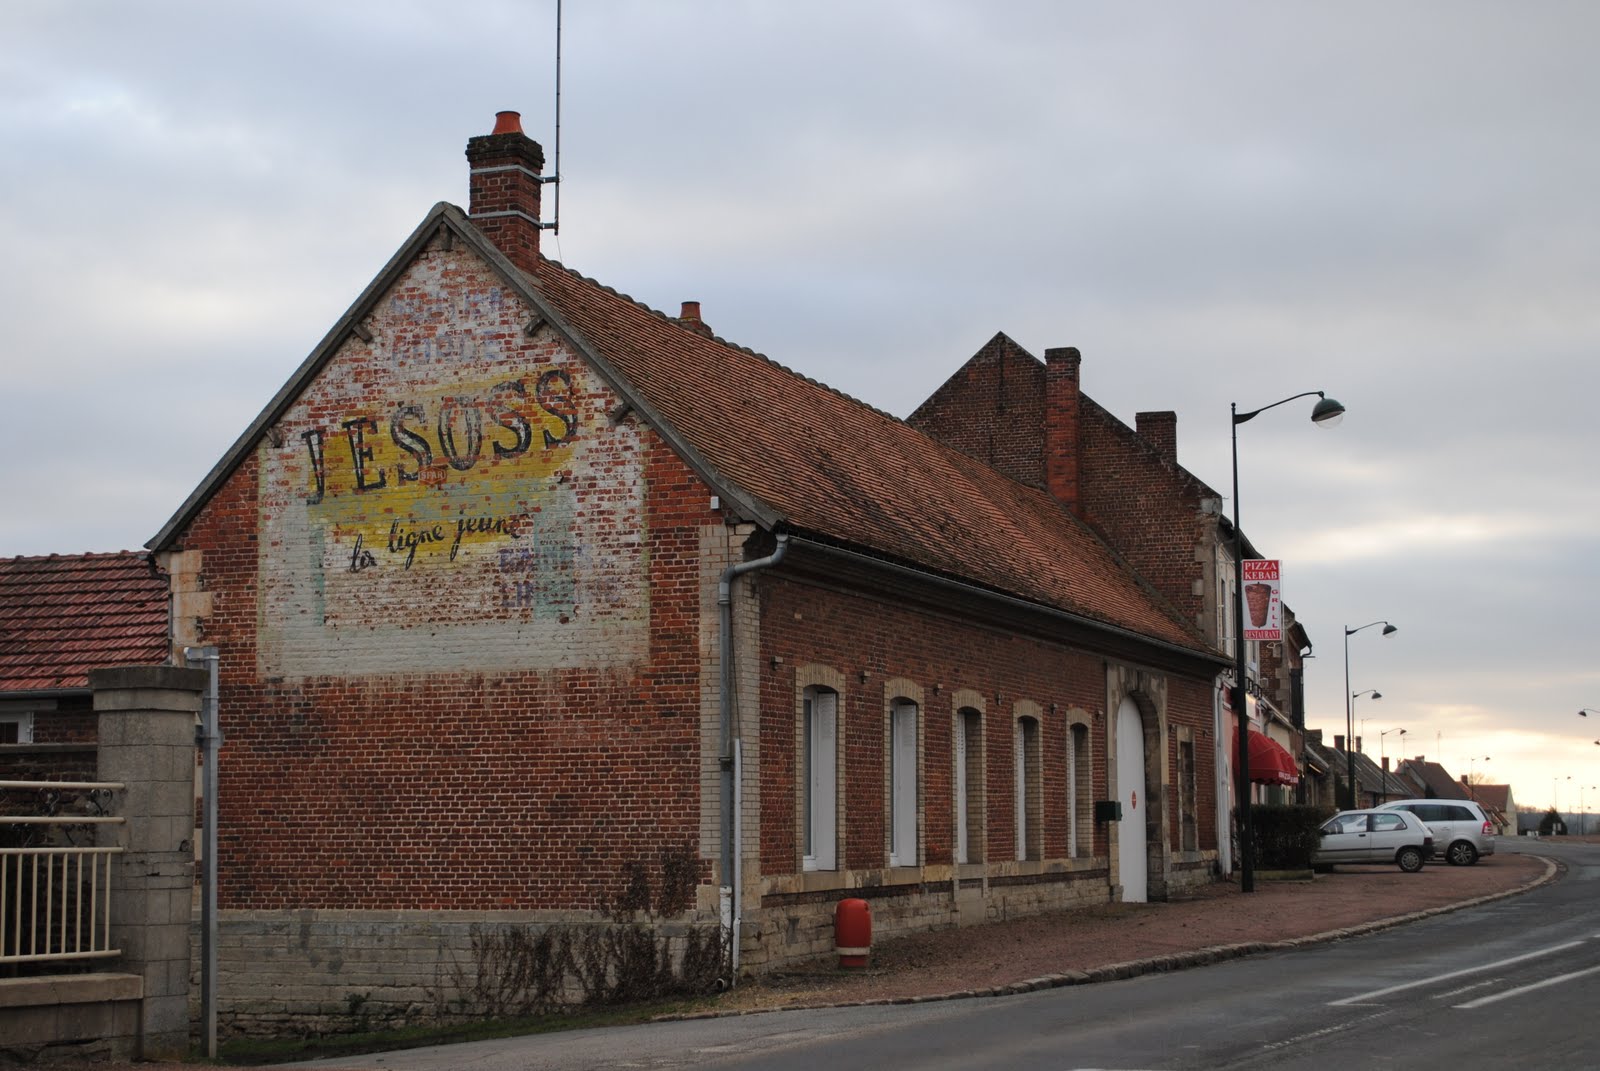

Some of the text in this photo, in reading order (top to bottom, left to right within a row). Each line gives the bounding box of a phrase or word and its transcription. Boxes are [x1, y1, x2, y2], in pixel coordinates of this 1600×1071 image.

[387, 517, 445, 571] ligne
[450, 510, 521, 562] jeune
[1244, 562, 1277, 571] PIZZA
[1244, 571, 1278, 580] KEBAB
[1244, 630, 1279, 639] RESTAURANT
